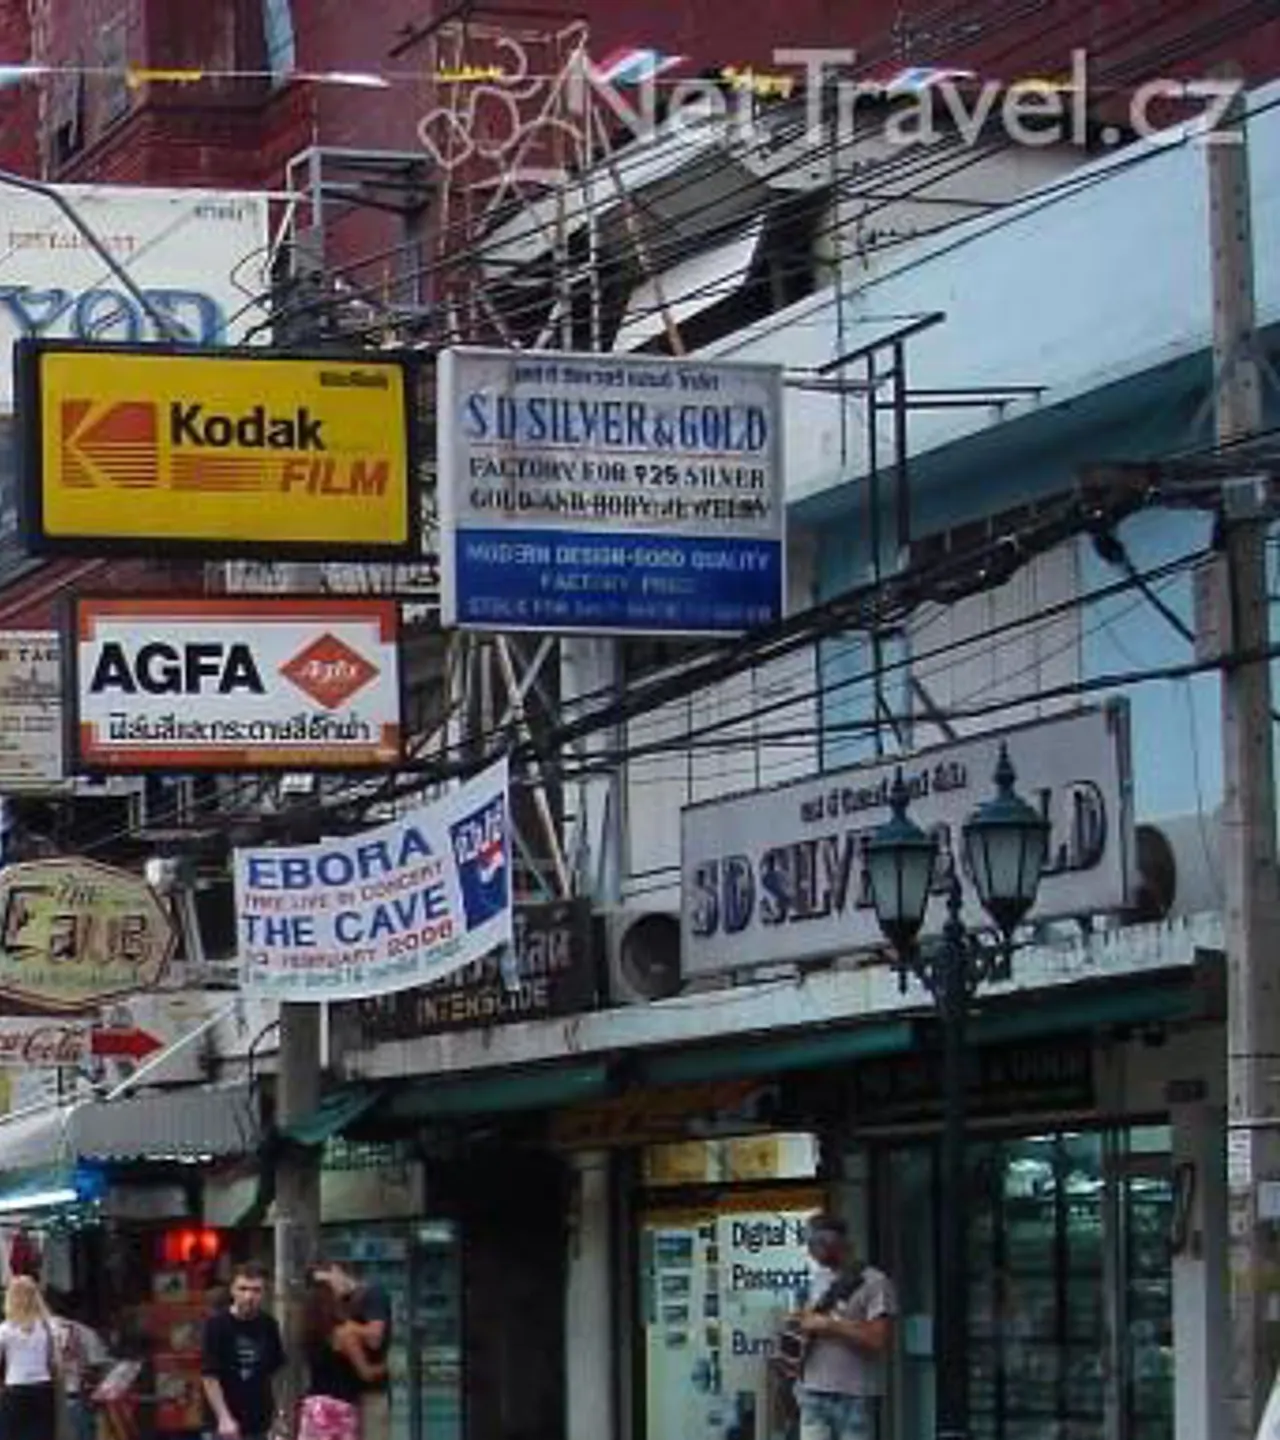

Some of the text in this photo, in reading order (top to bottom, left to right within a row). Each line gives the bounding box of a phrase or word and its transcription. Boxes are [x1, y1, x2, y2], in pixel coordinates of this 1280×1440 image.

[169, 402, 326, 452] Kodak
[526, 396, 648, 447] SILVER
[652, 415, 678, 448] &
[680, 403, 769, 453] GOLD
[278, 457, 390, 496] FILM
[90, 641, 266, 696] AGFA
[246, 827, 434, 891] EBORA
[240, 884, 450, 948] THE CAVE
[732, 1219, 787, 1253] Digital
[731, 1263, 810, 1297] Passport
